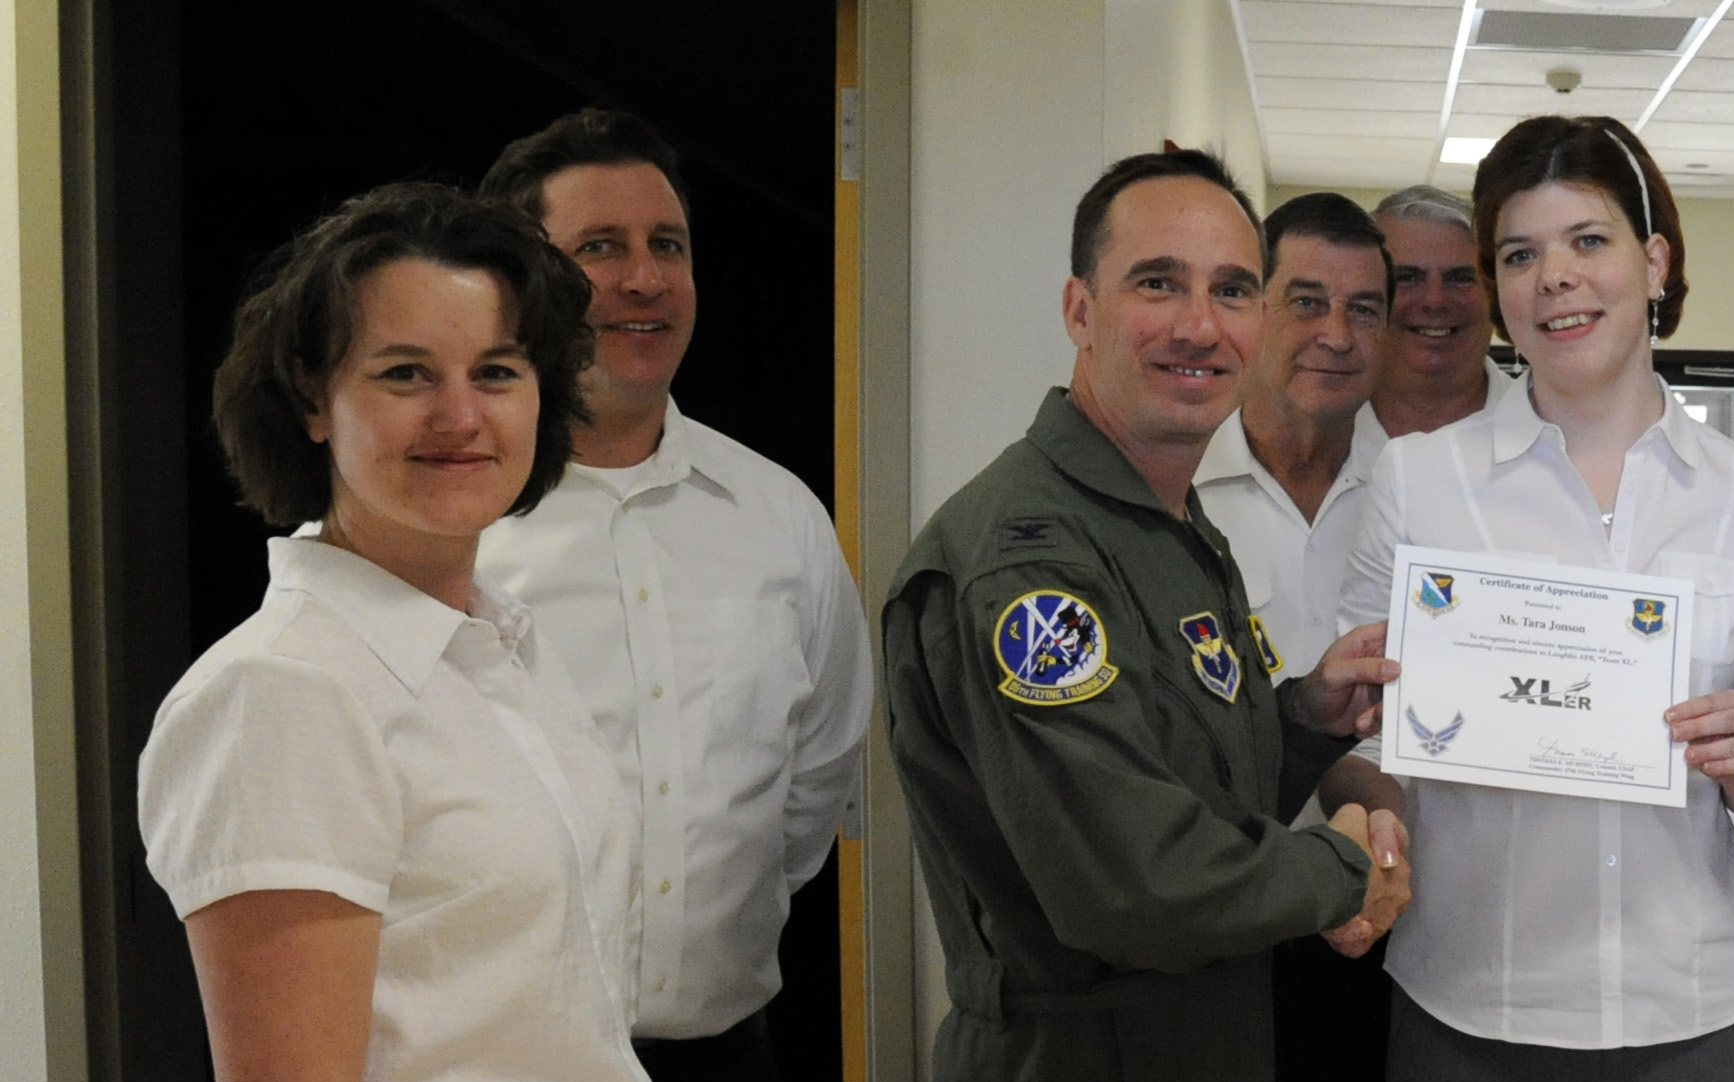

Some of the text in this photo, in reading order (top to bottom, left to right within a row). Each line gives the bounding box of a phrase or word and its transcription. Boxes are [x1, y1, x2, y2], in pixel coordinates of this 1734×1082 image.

[1480, 577, 1609, 600] Certificate of Appreciation
[1524, 601, 1553, 610] Presented
[1499, 614, 1586, 634] Ms. Tara Jonson
[1479, 634, 1517, 645] recognition
[1029, 688, 1063, 700] FLYING
[1063, 675, 1104, 698] TRAINING
